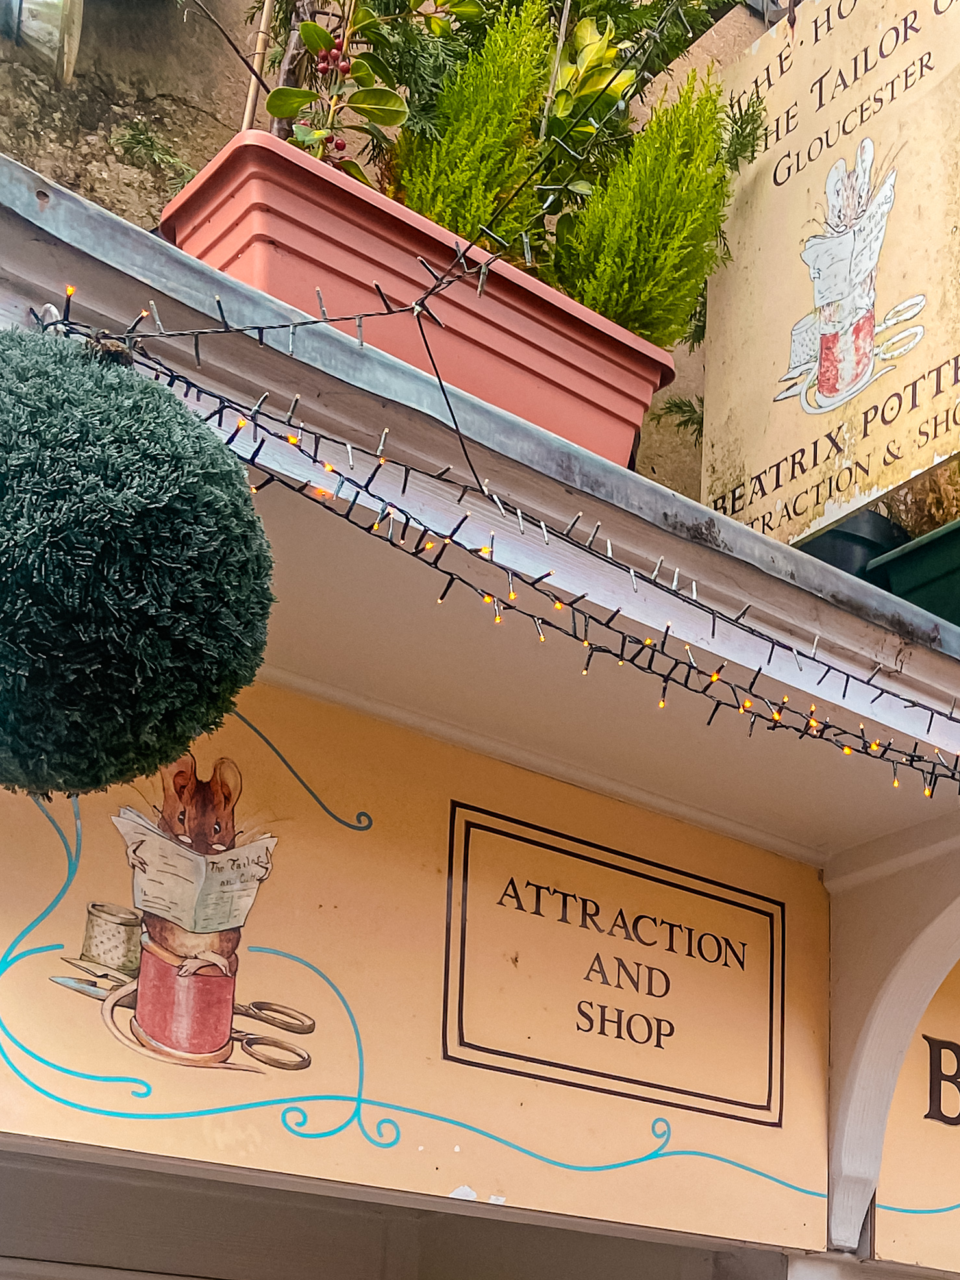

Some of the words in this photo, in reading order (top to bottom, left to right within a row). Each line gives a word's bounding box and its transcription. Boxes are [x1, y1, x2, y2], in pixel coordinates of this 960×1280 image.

[762, 101, 799, 153] HE
[810, 9, 921, 113] TAILOR
[772, 51, 935, 187] GLOUCESTER
[712, 422, 845, 517] BEATRIX
[882, 439, 904, 467] &
[496, 877, 748, 971] ATTRACTION
[583, 953, 671, 998] AND
[576, 1000, 675, 1050] SHOP
